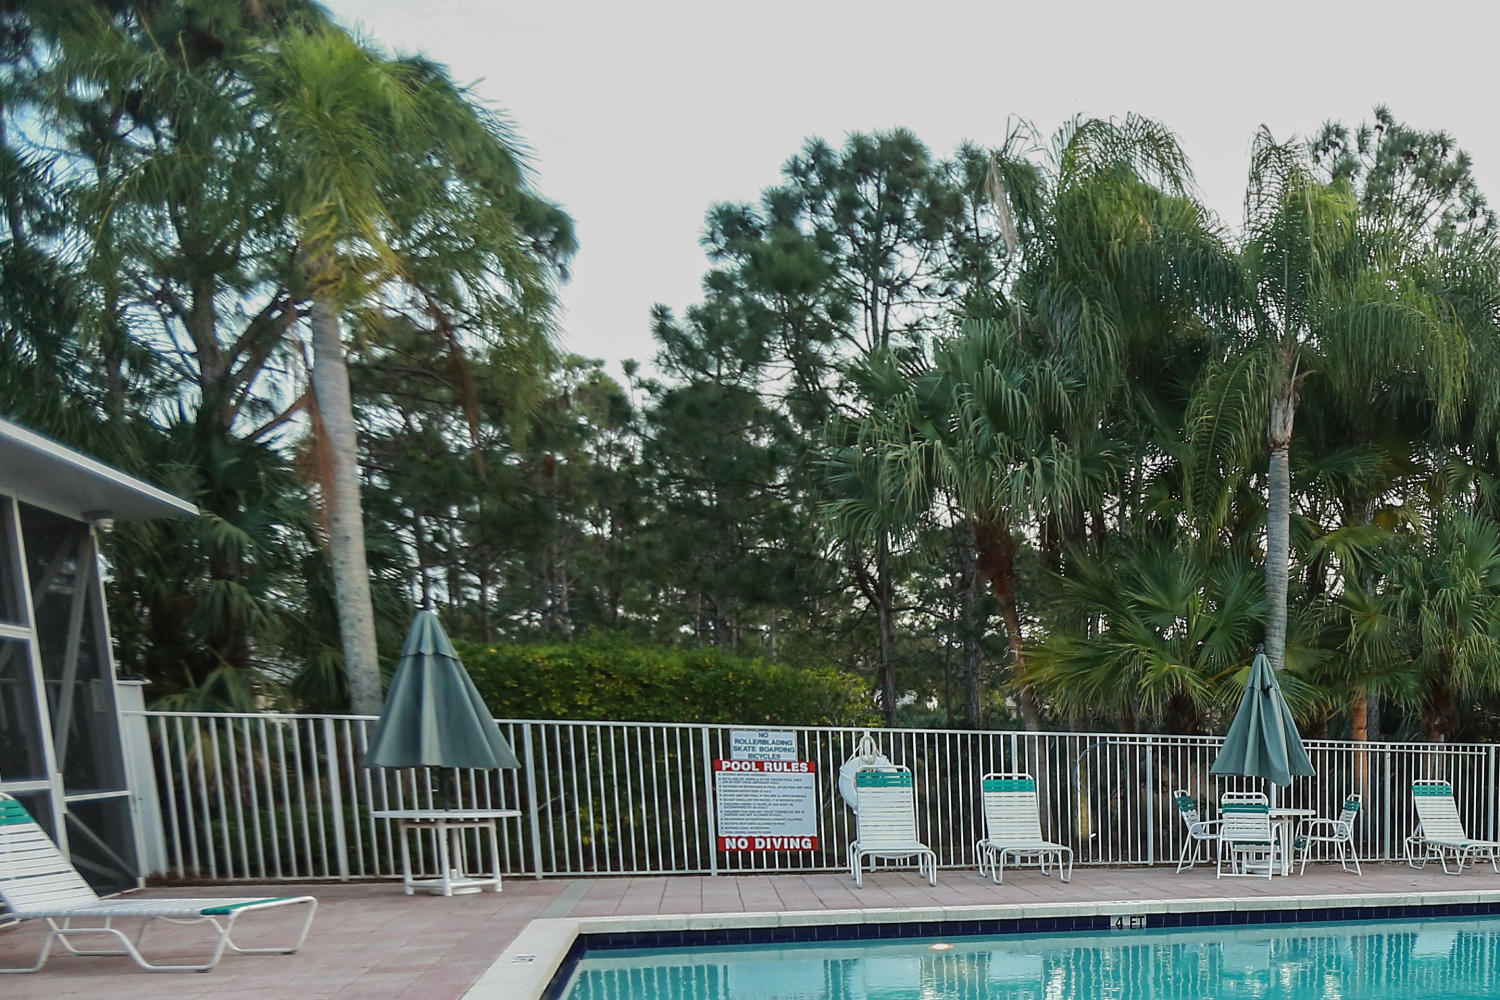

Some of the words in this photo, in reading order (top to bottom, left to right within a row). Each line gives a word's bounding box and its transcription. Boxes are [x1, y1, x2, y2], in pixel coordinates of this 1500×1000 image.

[721, 760, 760, 771] POOL
[763, 761, 809, 772] RULES
[725, 837, 749, 850] NO
[754, 837, 812, 850] DIVING
[1115, 916, 1124, 930] 4
